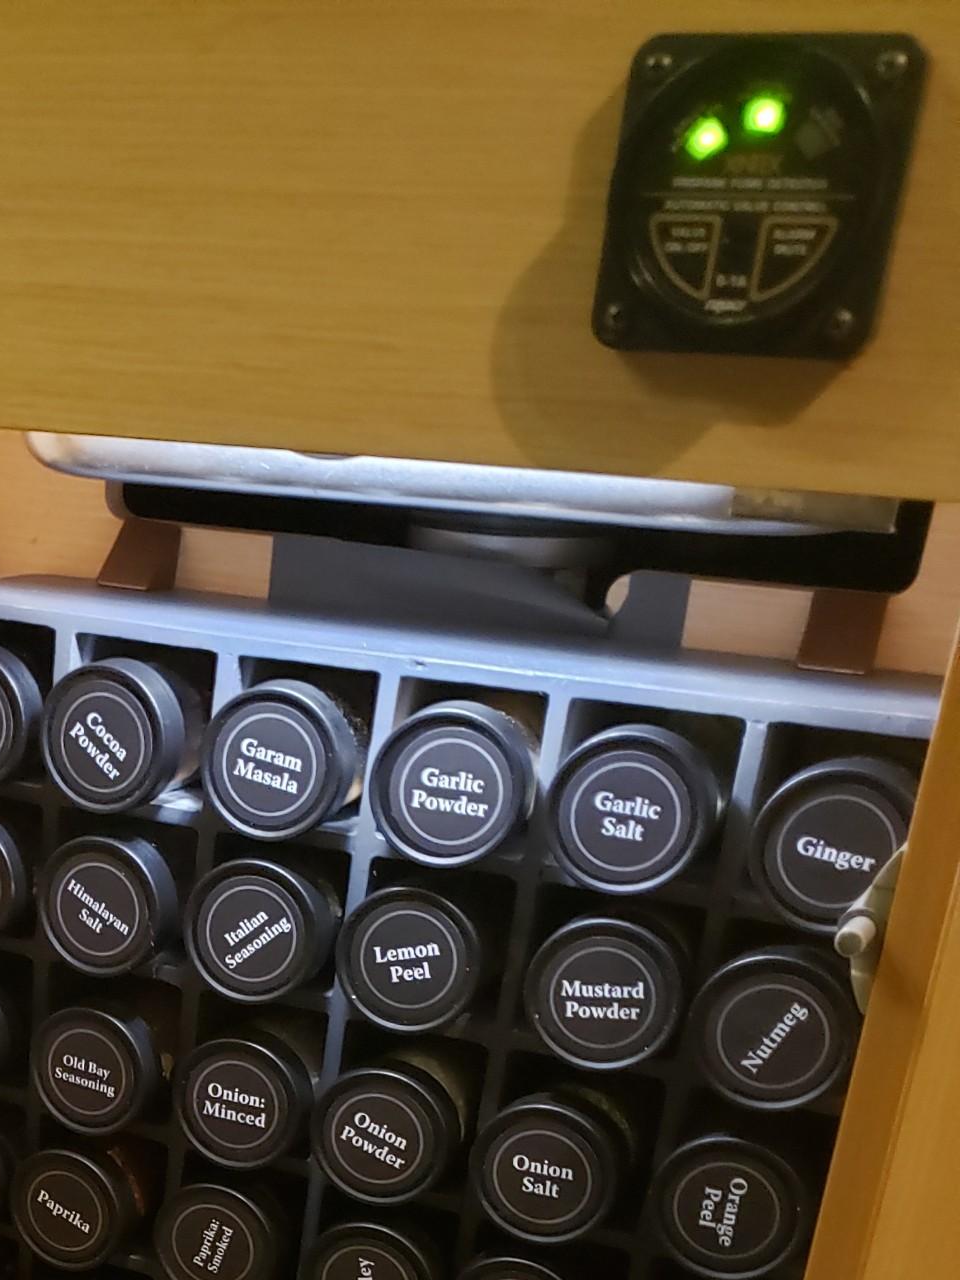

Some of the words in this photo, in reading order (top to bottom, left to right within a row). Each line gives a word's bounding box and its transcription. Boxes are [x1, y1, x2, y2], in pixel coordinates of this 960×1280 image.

[69, 722, 121, 781] Powder
[86, 712, 127, 762] Cocoa
[240, 738, 303, 772] Garam
[233, 759, 299, 794] Masala
[420, 768, 486, 794] Garlic
[411, 789, 488, 818] Powder
[595, 792, 661, 820] Garlic
[601, 817, 644, 842] Salt
[797, 837, 876, 873] Ginger
[67, 879, 129, 936] Himalayan
[78, 908, 104, 935] Salt
[224, 909, 269, 948] Italian
[225, 916, 292, 969] Seasoning
[374, 942, 440, 963] Lemon
[390, 963, 431, 983] Peel
[561, 980, 645, 1000] Mustard
[565, 1002, 640, 1020] Powder
[741, 1001, 809, 1073] Nutmeg
[54, 1067, 116, 1098] Seasoning
[62, 1054, 85, 1072] Old
[88, 1062, 111, 1080] Bay
[207, 1082, 265, 1109] Onion:
[203, 1100, 266, 1129] Minced
[353, 1111, 408, 1150] Onion
[340, 1126, 405, 1170] Powder
[512, 1155, 574, 1180] Onion
[521, 1177, 560, 1198] Salt
[37, 1190, 90, 1234] Paprika
[699, 1186, 722, 1228] Peel
[718, 1177, 748, 1247] Orange
[193, 1218, 220, 1267] Paprika:
[207, 1226, 234, 1274] Smoked
